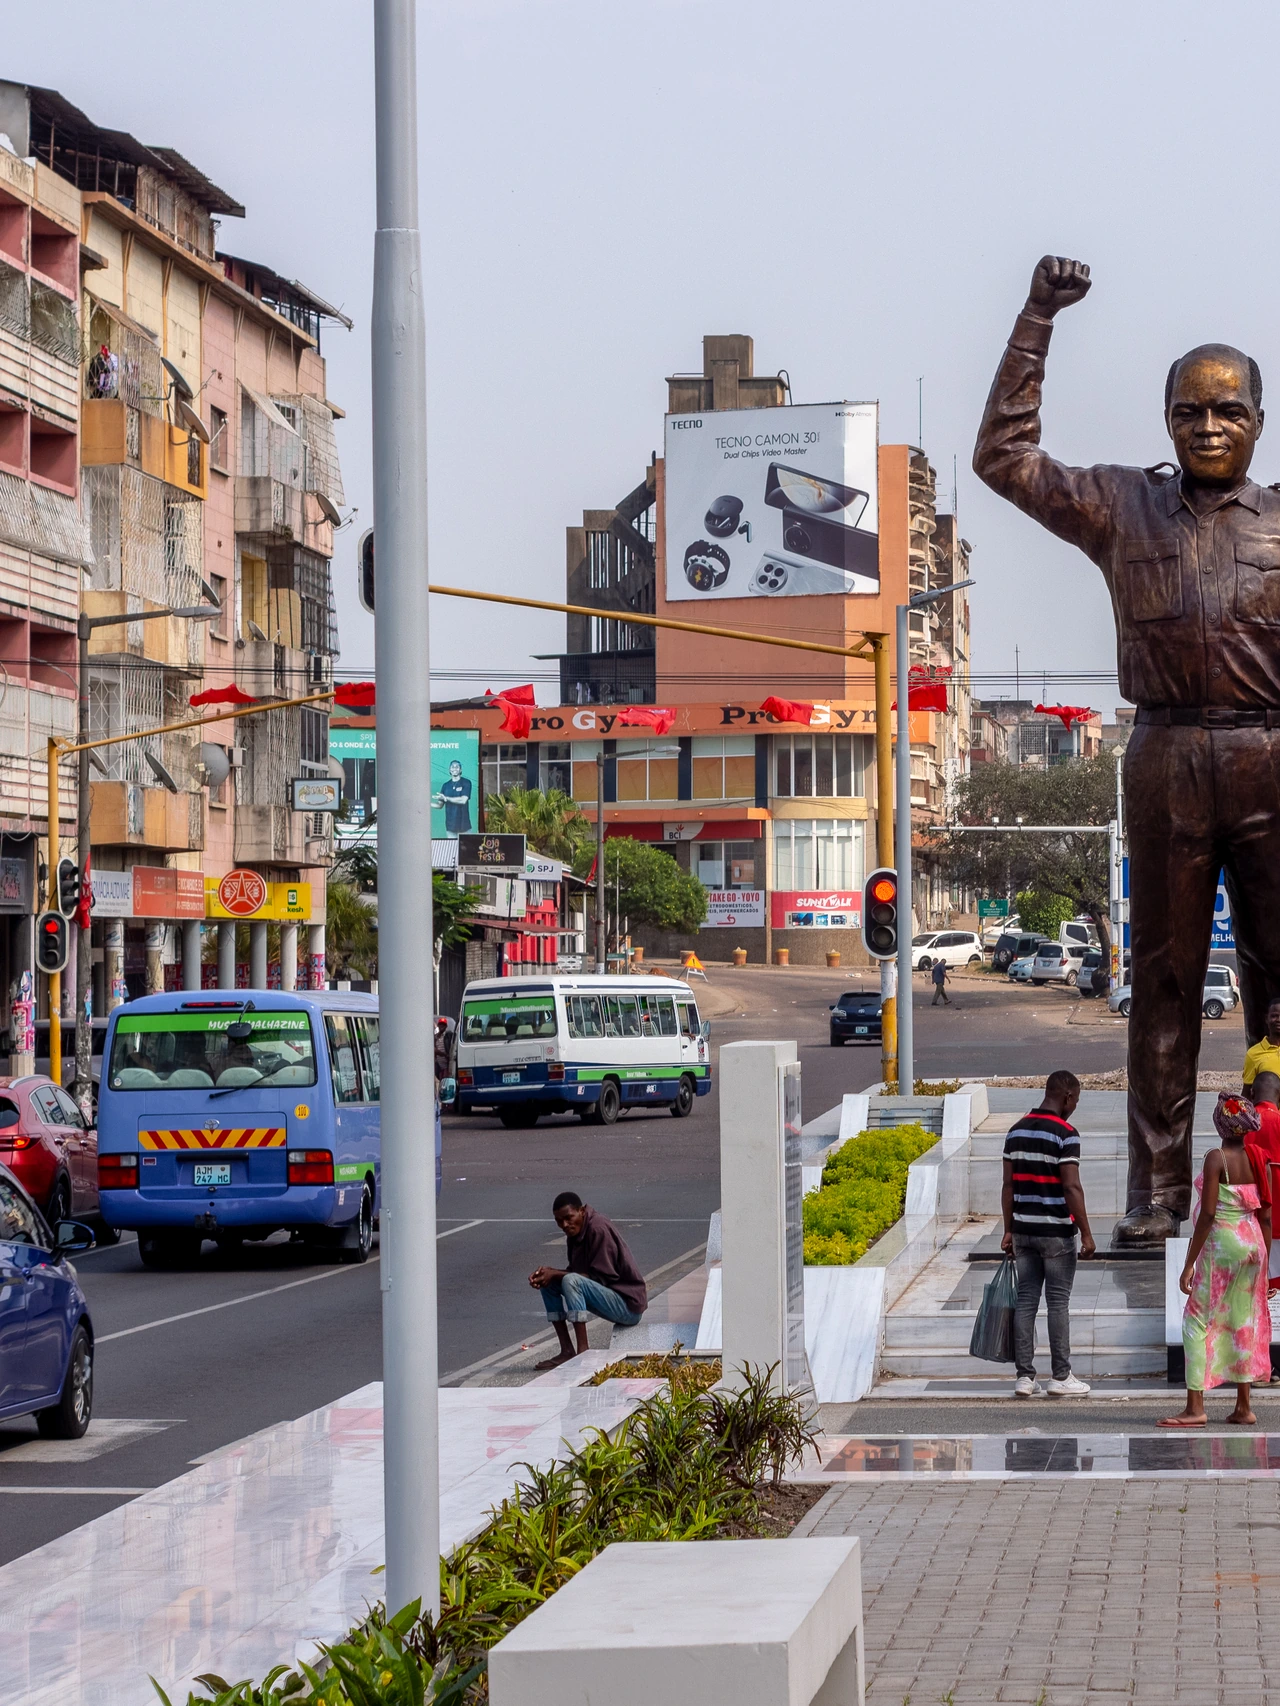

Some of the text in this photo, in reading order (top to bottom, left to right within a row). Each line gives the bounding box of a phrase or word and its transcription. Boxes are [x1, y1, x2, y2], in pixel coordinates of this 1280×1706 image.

[671, 419, 703, 430] TECNO
[715, 435, 752, 449] TECNO
[755, 432, 799, 446] CAMON
[803, 431, 817, 444] 30
[724, 447, 807, 459] Dual Chips Video Master
[531, 716, 564, 730] ro
[669, 831, 681, 840] BCI
[481, 836, 500, 849] Loja
[537, 865, 554, 873] SPJ
[709, 893, 726, 903] TAKE
[727, 893, 737, 903] GO
[742, 892, 760, 902] YOYO
[196, 1166, 213, 1175] AJM
[196, 1174, 230, 1184] 747 MC
